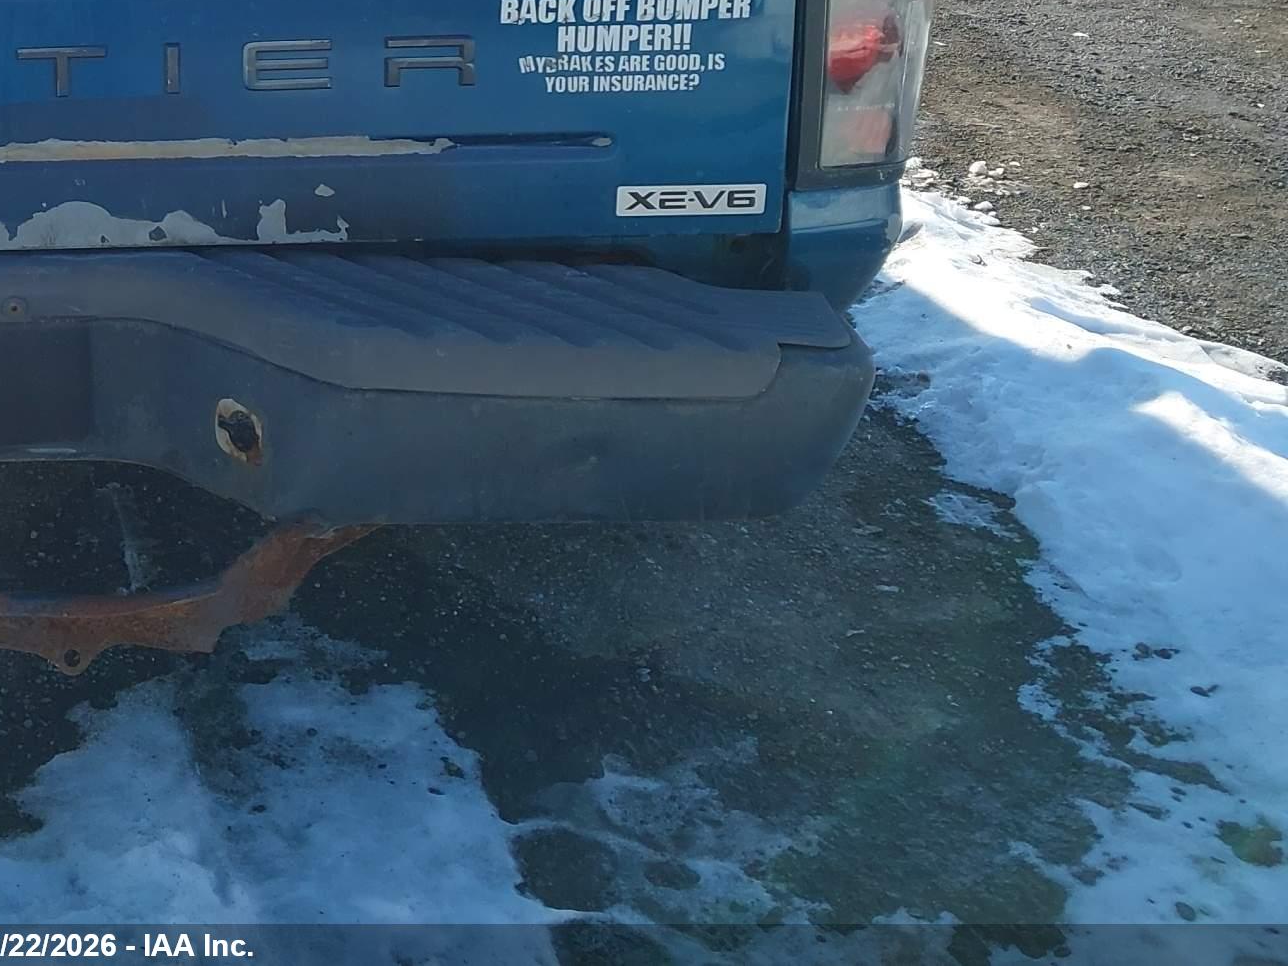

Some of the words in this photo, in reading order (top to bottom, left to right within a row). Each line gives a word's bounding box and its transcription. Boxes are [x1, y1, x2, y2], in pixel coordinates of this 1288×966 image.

[557, 23, 693, 53] HUMPER!!
[617, 54, 651, 72] ARE
[653, 53, 706, 73] GOOD,
[707, 53, 725, 71] IS
[545, 75, 590, 93] YOUR
[592, 73, 700, 93] INSURANCE?
[624, 189, 756, 211] XE-V6
